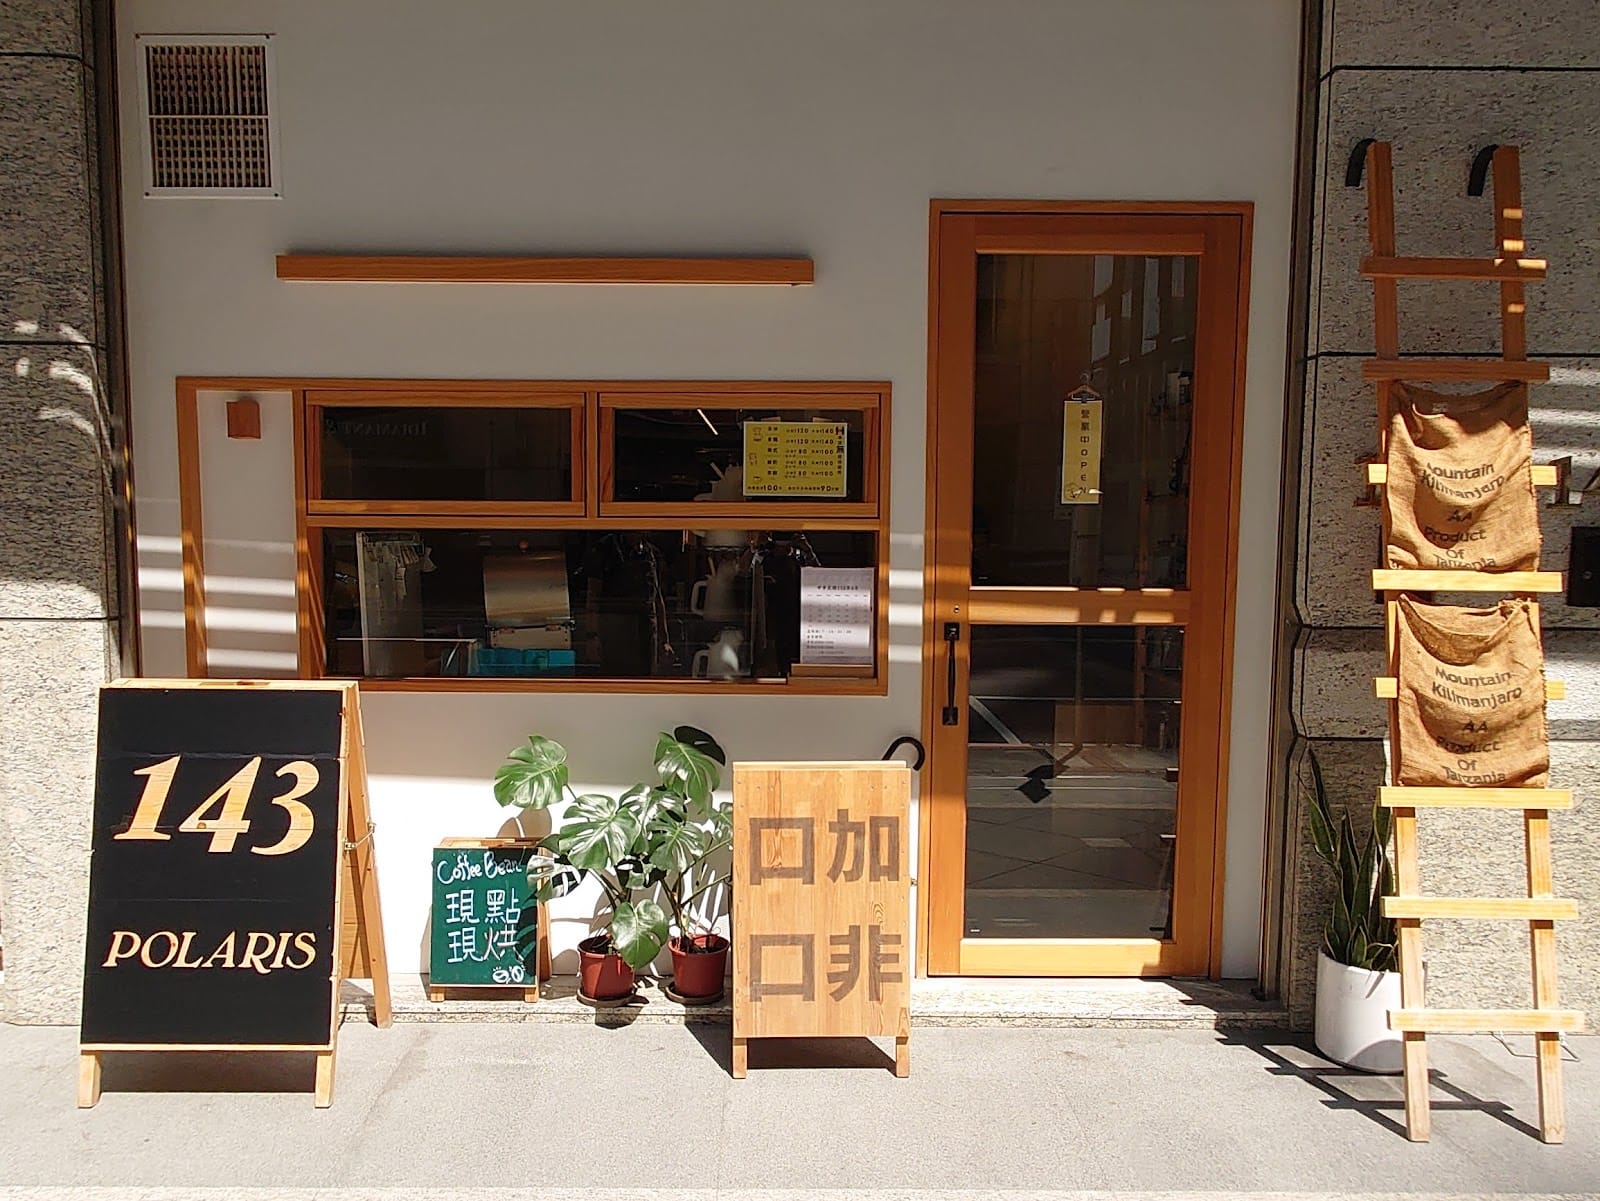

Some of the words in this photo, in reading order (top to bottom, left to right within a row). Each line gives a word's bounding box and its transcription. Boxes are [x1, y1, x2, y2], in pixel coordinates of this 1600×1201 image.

[1424, 525, 1488, 543] Product
[1446, 548, 1466, 560] Of
[1435, 666, 1512, 687] Mountain
[1431, 681, 1523, 710] Kilimanjaro
[1462, 720, 1489, 733] AA
[1436, 735, 1502, 753] Product
[1441, 765, 1507, 784] Tanzania
[1457, 758, 1479, 771] Of
[112, 754, 321, 856] 143
[437, 852, 482, 885] Coffee
[445, 887, 521, 925] 現點
[102, 930, 317, 975] POLARIS
[447, 924, 525, 965] 現烘
